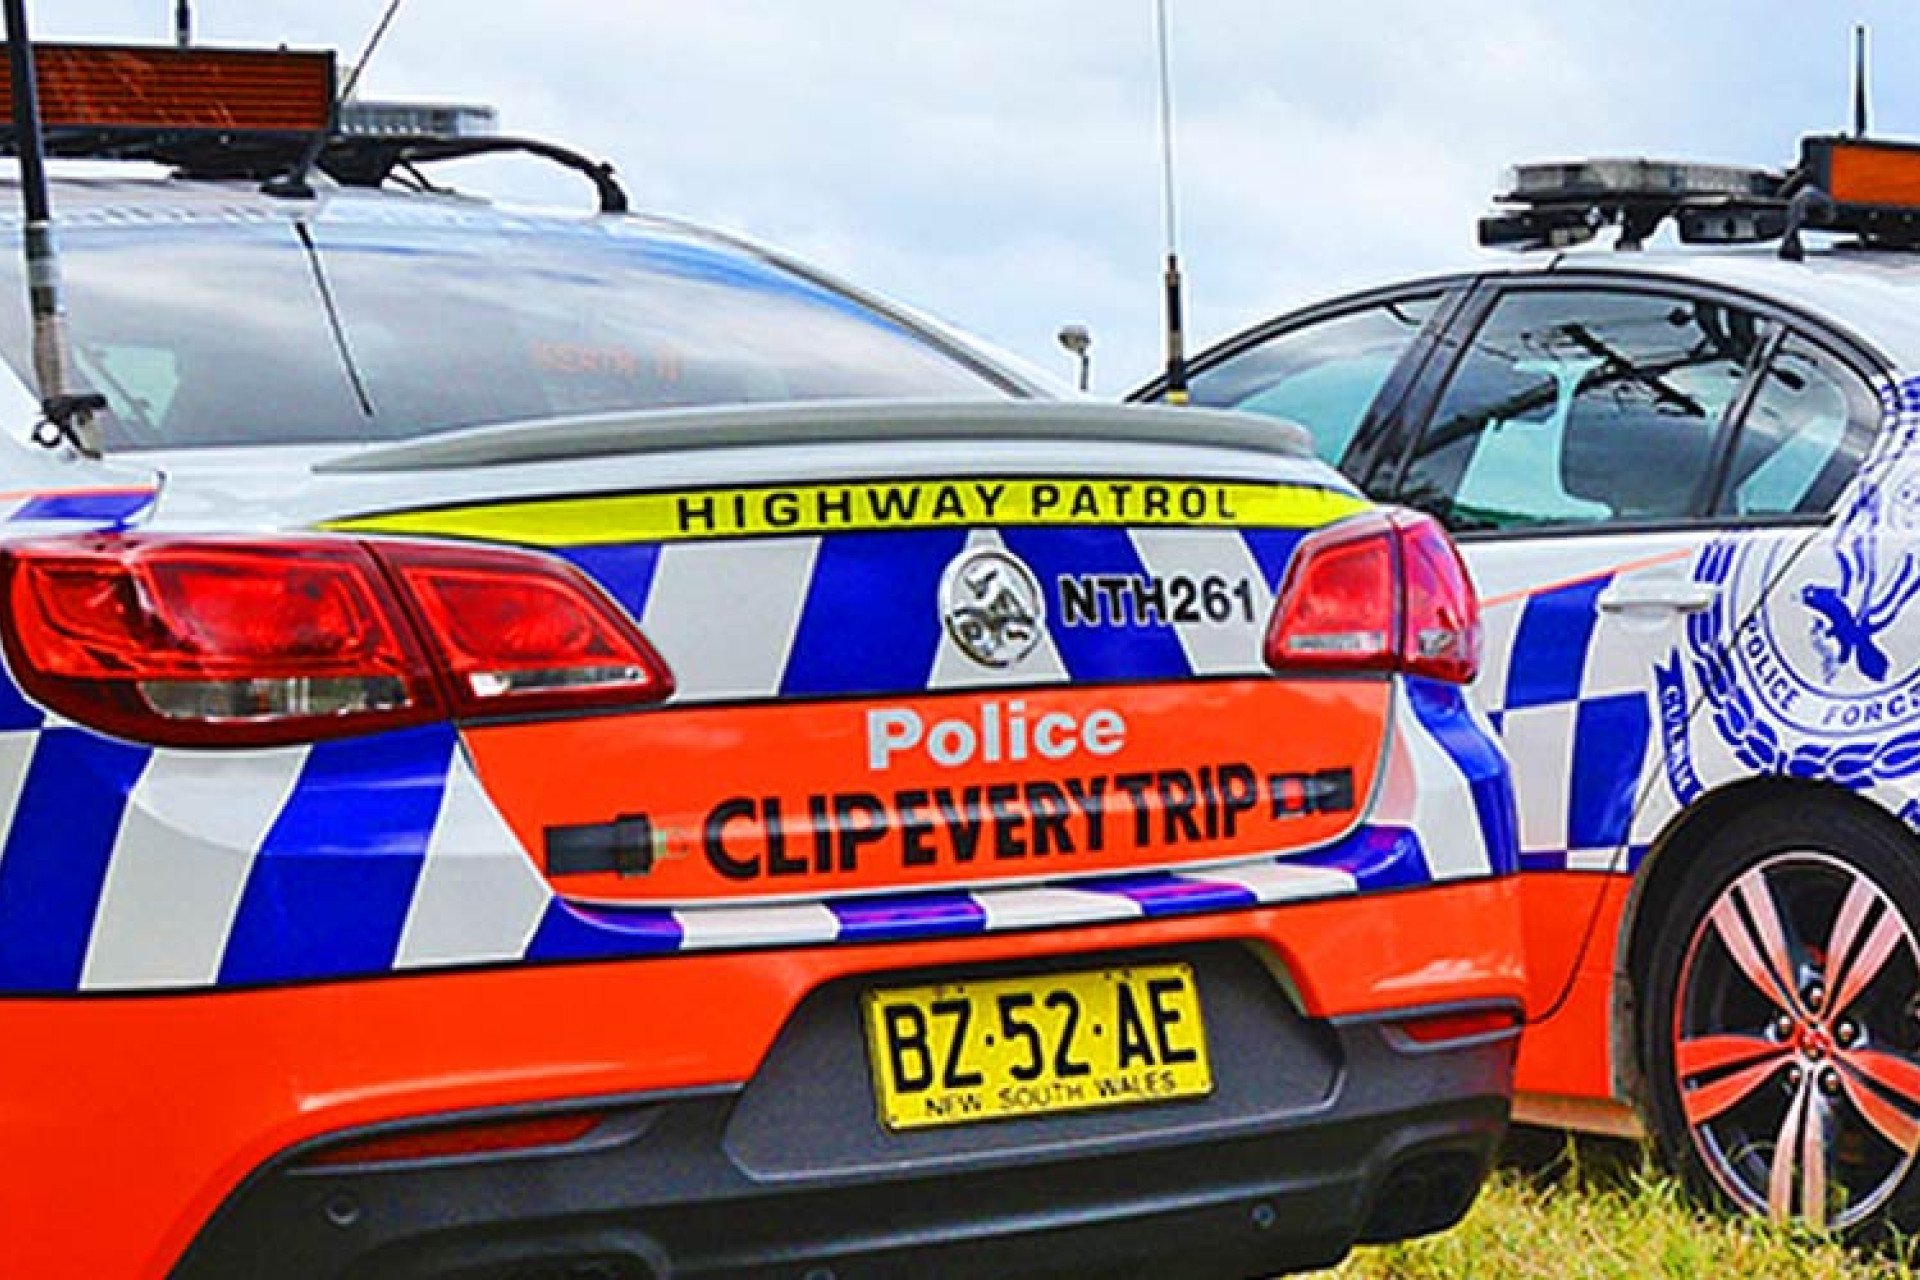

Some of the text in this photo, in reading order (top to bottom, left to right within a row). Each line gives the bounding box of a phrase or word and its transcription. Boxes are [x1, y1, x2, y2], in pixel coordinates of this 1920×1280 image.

[677, 485, 1238, 531] HIGHWAY PATROL
[1059, 576, 1256, 626] NTH261
[868, 701, 1127, 769] Police
[703, 761, 1257, 879] CLIP EVERY TRIP
[924, 1069, 1178, 1116] NEW SOUTH WALES
